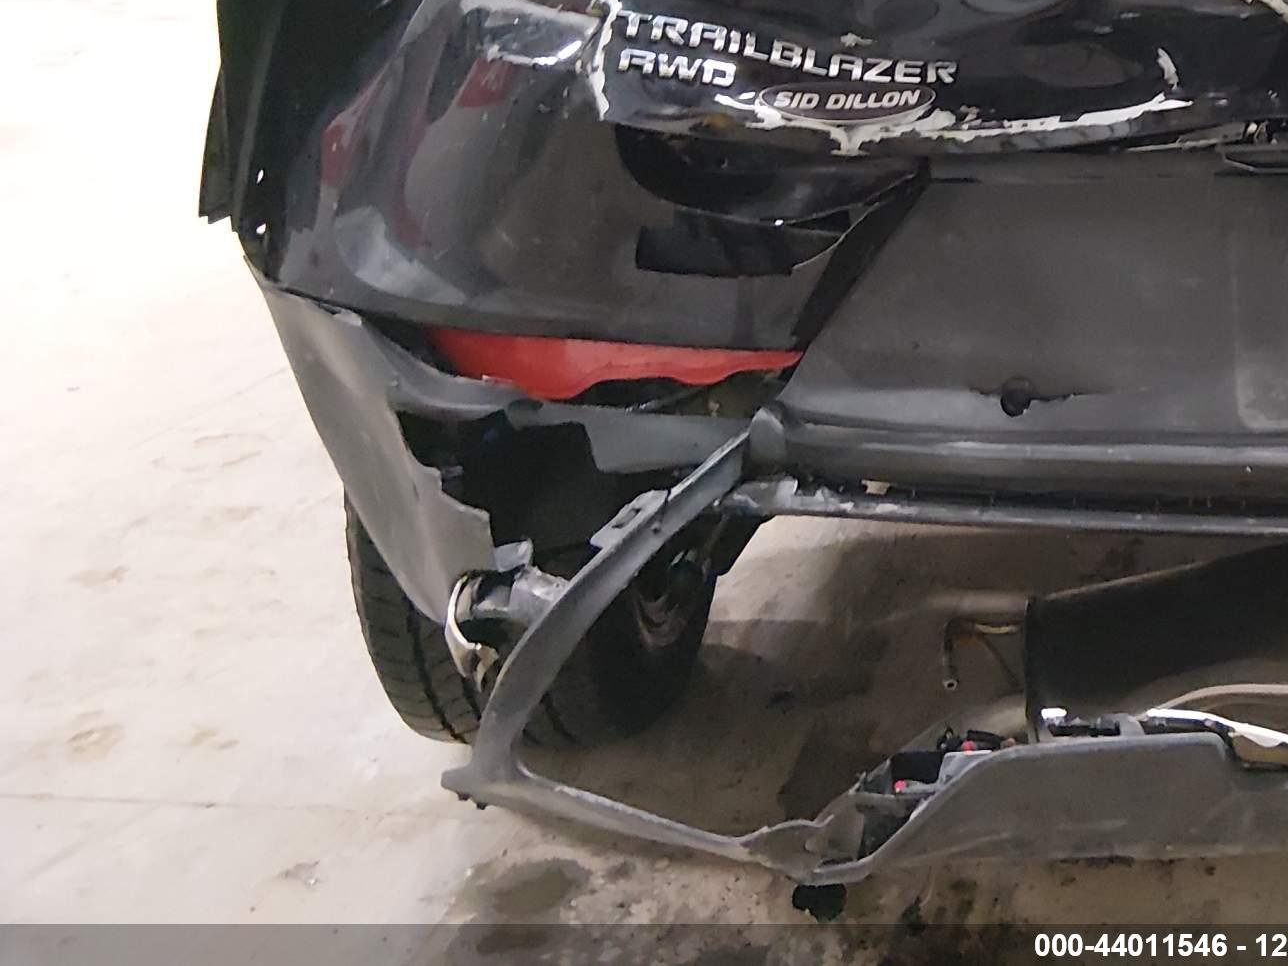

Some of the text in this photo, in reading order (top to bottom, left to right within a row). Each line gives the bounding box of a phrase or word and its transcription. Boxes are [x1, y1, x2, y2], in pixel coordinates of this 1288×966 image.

[616, 8, 958, 85] TRAILBLAZER
[617, 47, 738, 88] AWD
[772, 88, 921, 111] SID DILLON
